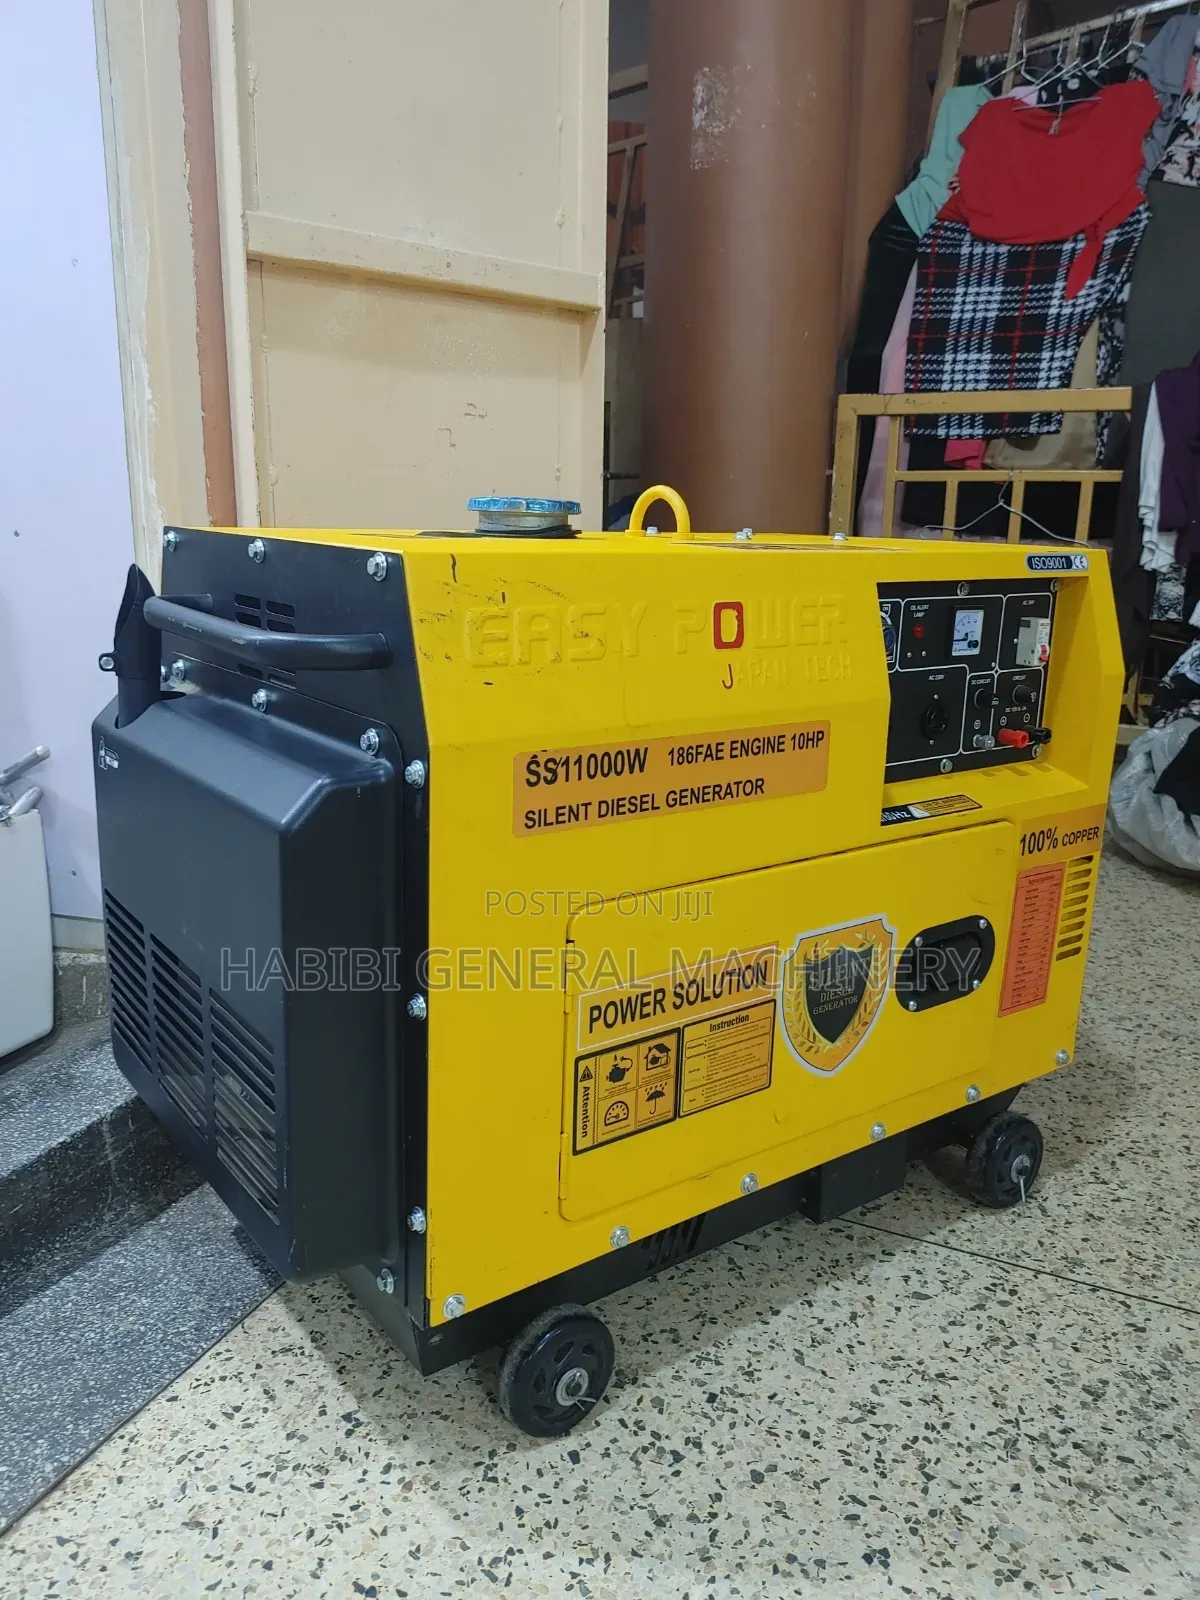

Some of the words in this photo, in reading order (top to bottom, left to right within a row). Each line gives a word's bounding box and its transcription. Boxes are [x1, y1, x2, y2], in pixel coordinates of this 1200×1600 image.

[1031, 557, 1067, 569] ISO9001
[466, 602, 648, 669] EASY
[672, 595, 848, 656] POWER
[721, 660, 790, 690] JAPAN
[804, 652, 854, 683] TECH
[525, 746, 649, 788] SS11000W
[667, 741, 725, 767] 186FAE
[729, 734, 786, 759] ENGINE
[790, 730, 825, 751] 10HP
[524, 801, 592, 830] SILENT
[597, 793, 661, 819] DIESEL
[665, 778, 765, 808] GENERATOR
[1019, 826, 1058, 857] 100%
[1061, 826, 1100, 847] COPPER
[808, 957, 871, 990] SILENT
[588, 987, 667, 1034] POWER
[672, 960, 768, 1011] SOLUTION
[812, 995, 859, 1015] GENERATOR
[819, 985, 854, 1003] DIESEL
[709, 1014, 750, 1033] Instruction
[581, 1085, 591, 1139] Attention
